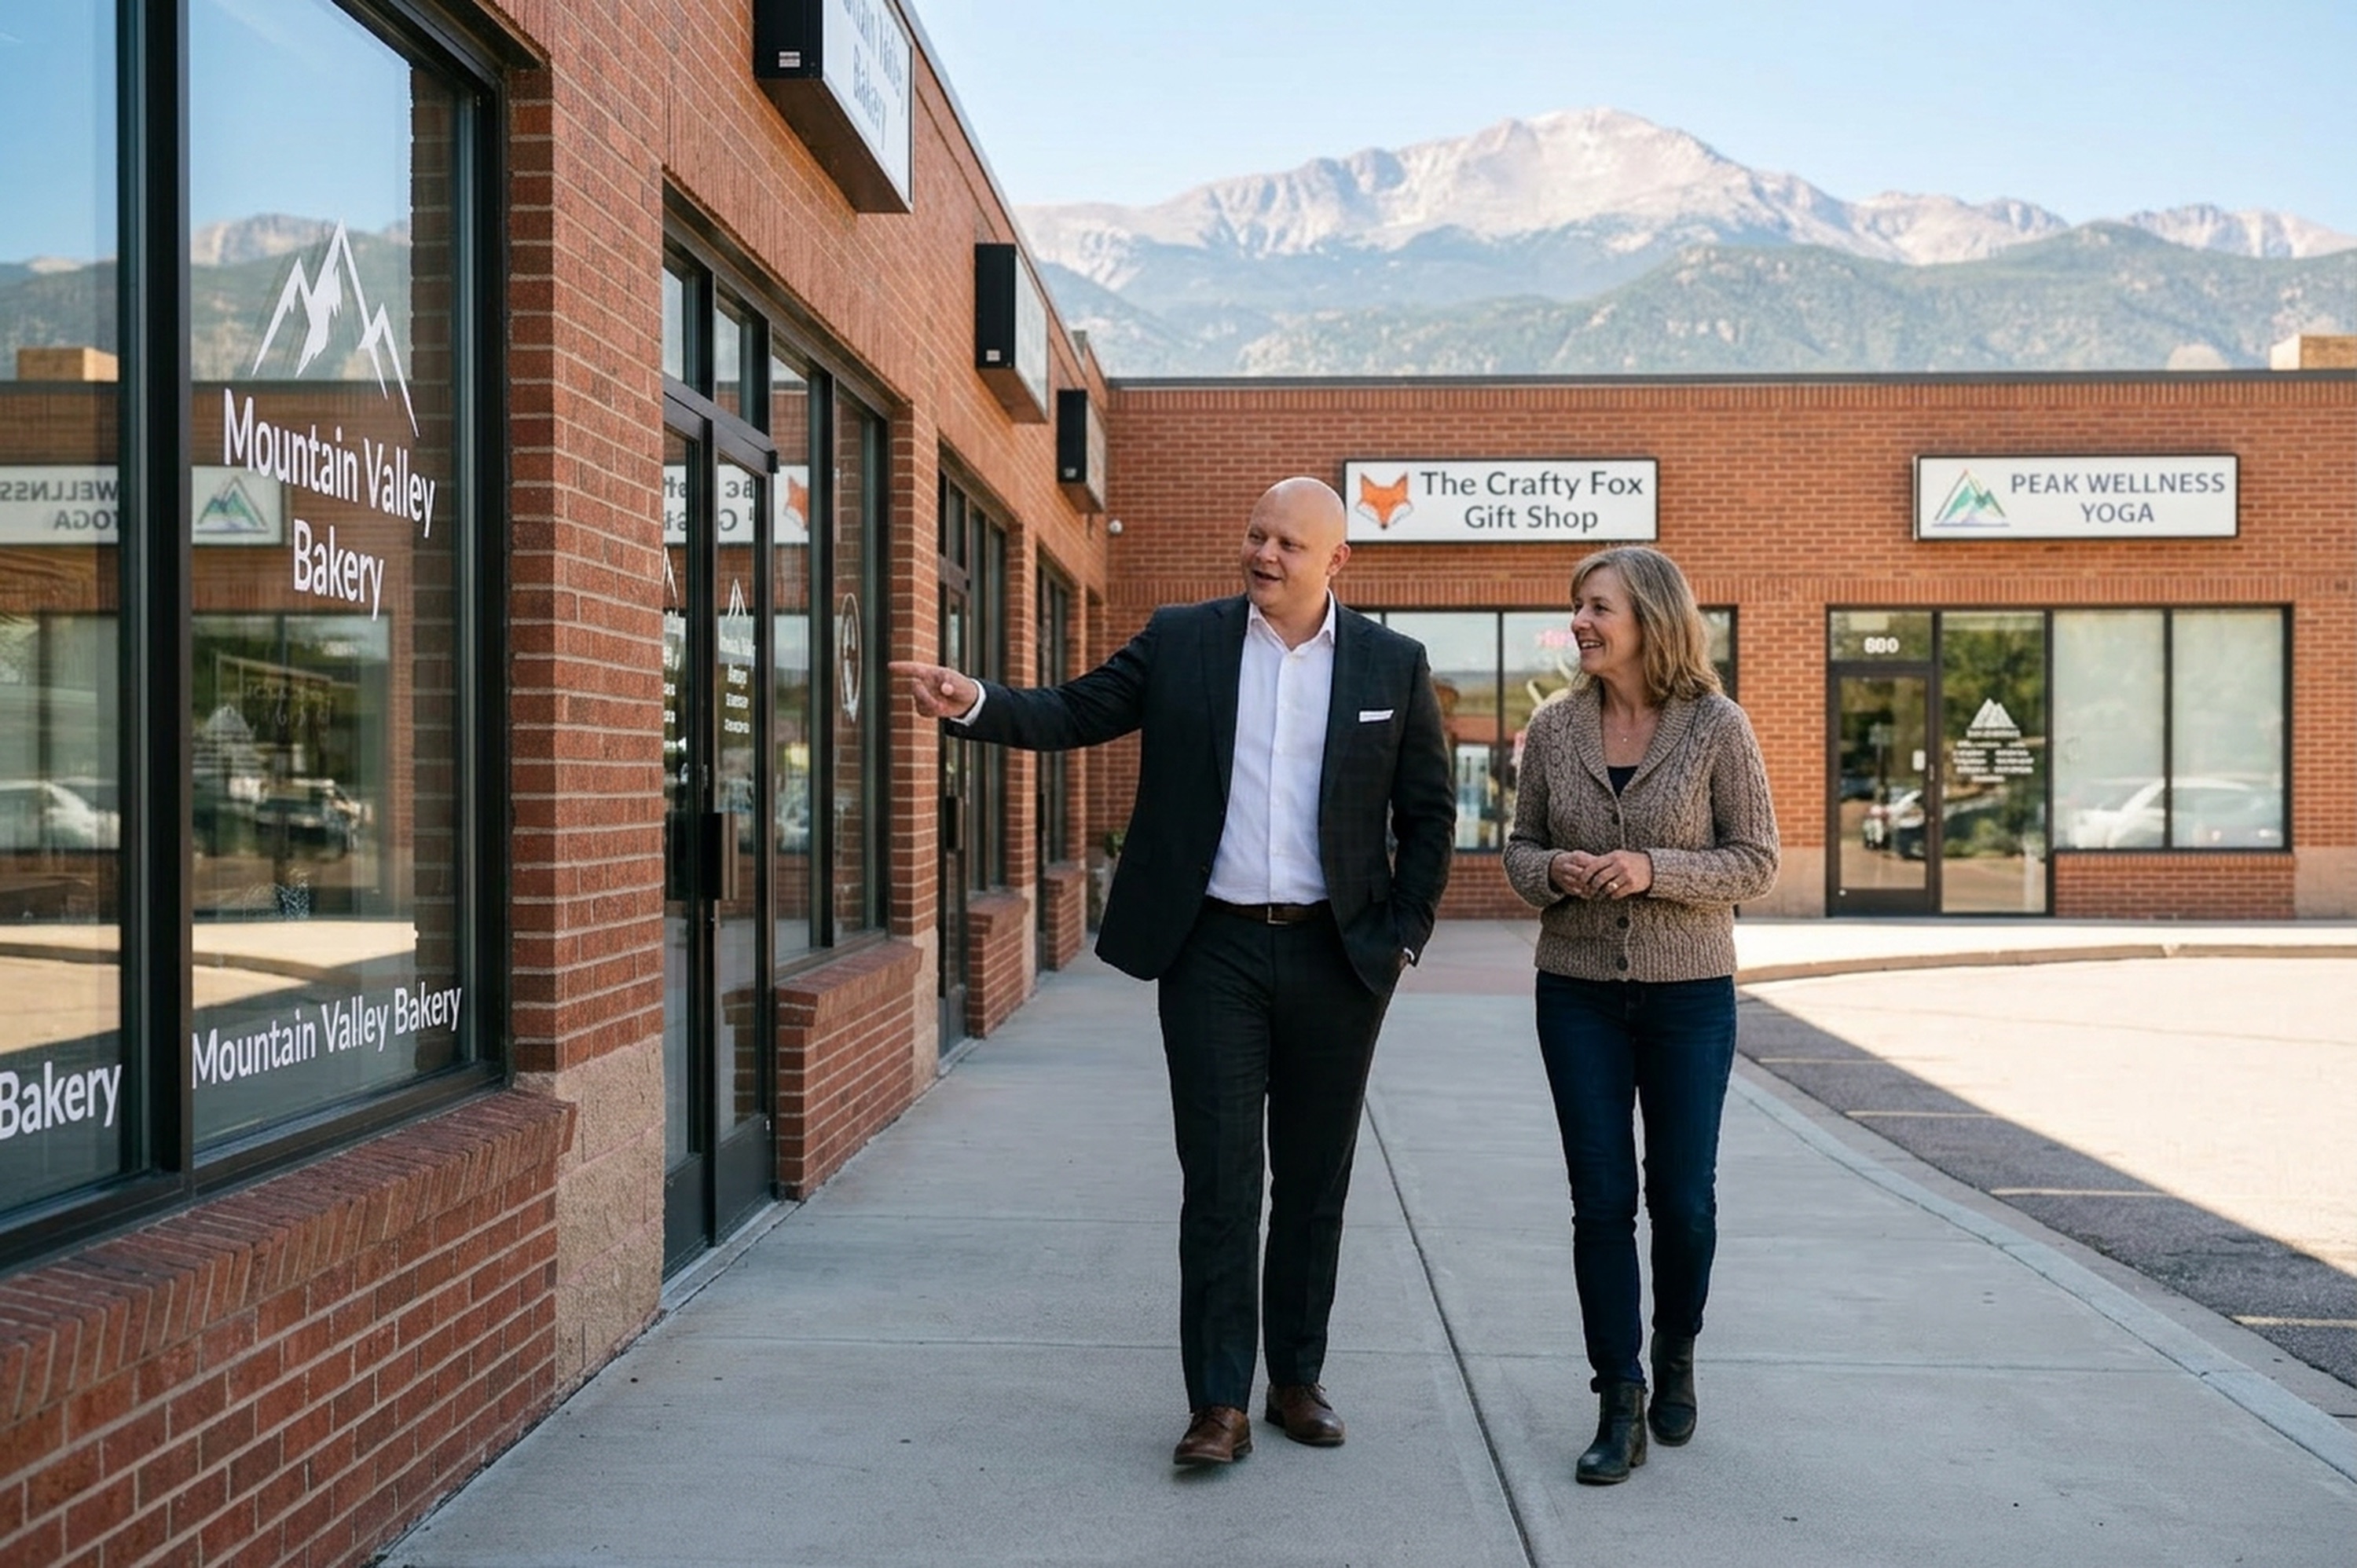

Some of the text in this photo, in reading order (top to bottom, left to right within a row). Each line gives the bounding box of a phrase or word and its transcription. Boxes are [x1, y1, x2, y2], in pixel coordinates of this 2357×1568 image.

[853, 42, 887, 151] Bakery
[224, 387, 435, 539] Mountain Valley
[1420, 471, 1644, 500] The Crafty Fox
[2011, 472, 2226, 494] PEAK WELLNESS
[1464, 505, 1600, 533] Gift Shop
[2080, 502, 2155, 523] YOGA
[293, 518, 384, 622] Bakery
[191, 982, 462, 1090] Mountain Valley Bakery
[0, 1061, 122, 1140] Bakery
